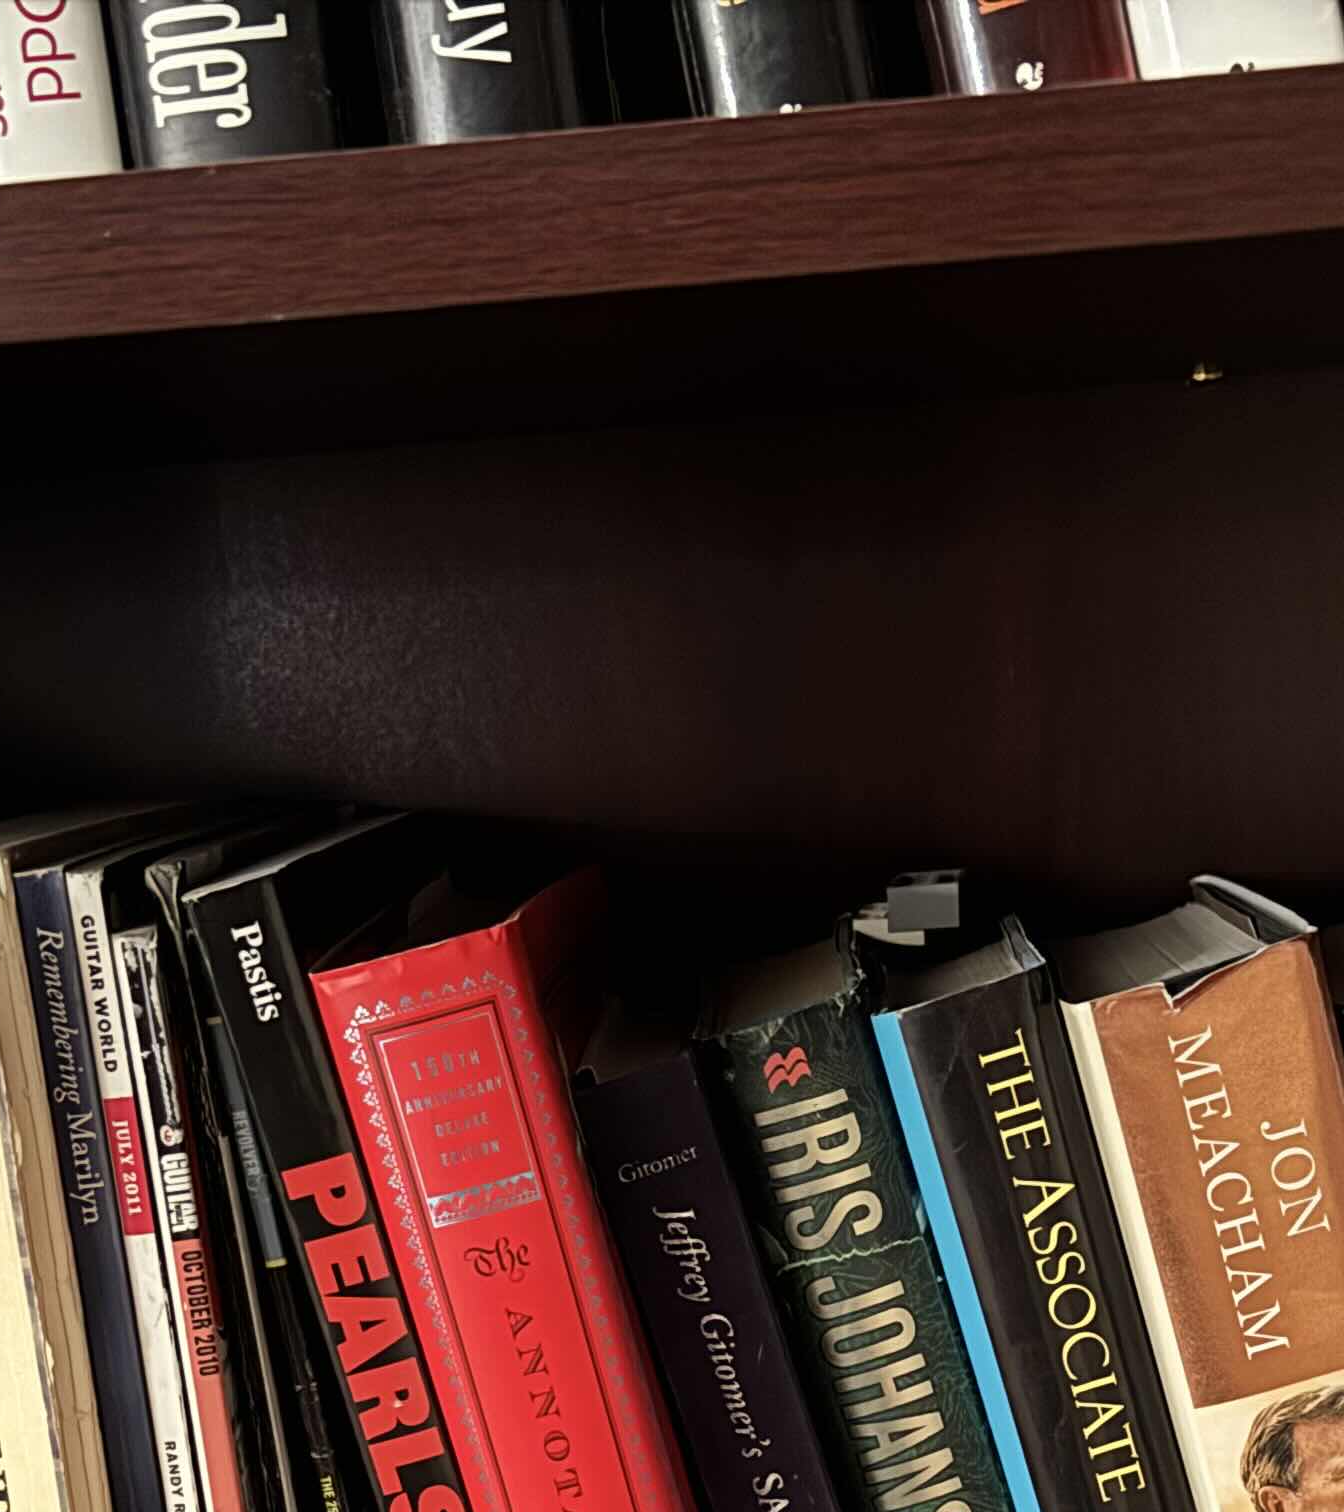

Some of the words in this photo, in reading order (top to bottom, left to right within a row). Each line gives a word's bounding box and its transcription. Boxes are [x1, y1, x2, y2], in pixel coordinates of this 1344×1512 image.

[79, 915, 105, 992] GUITAR
[92, 995, 119, 1074] WORLD
[230, 921, 280, 1024] Pastis
[34, 923, 83, 1109] Remembering
[64, 1108, 102, 1227] Marilyn
[978, 1028, 1054, 1162] THE
[110, 1118, 135, 1170] JULY
[230, 1108, 261, 1177] REVOLVER
[618, 1144, 699, 1187] Gitomer
[754, 1088, 884, 1254] IRIS
[1261, 1119, 1331, 1238] JON
[120, 1170, 144, 1218] 2011
[158, 1150, 201, 1234] GUITAR
[1168, 1024, 1291, 1361] MEACHAM
[177, 1248, 213, 1332] OCTOBER
[463, 1235, 532, 1283] The
[192, 1332, 221, 1377] 2010
[651, 1195, 717, 1313] Jeffrey
[693, 1307, 774, 1464] Gitomer's
[1013, 1176, 1147, 1504] ASSOCIATE
[161, 1439, 185, 1501] RANDY
[317, 1474, 336, 1499] THE
